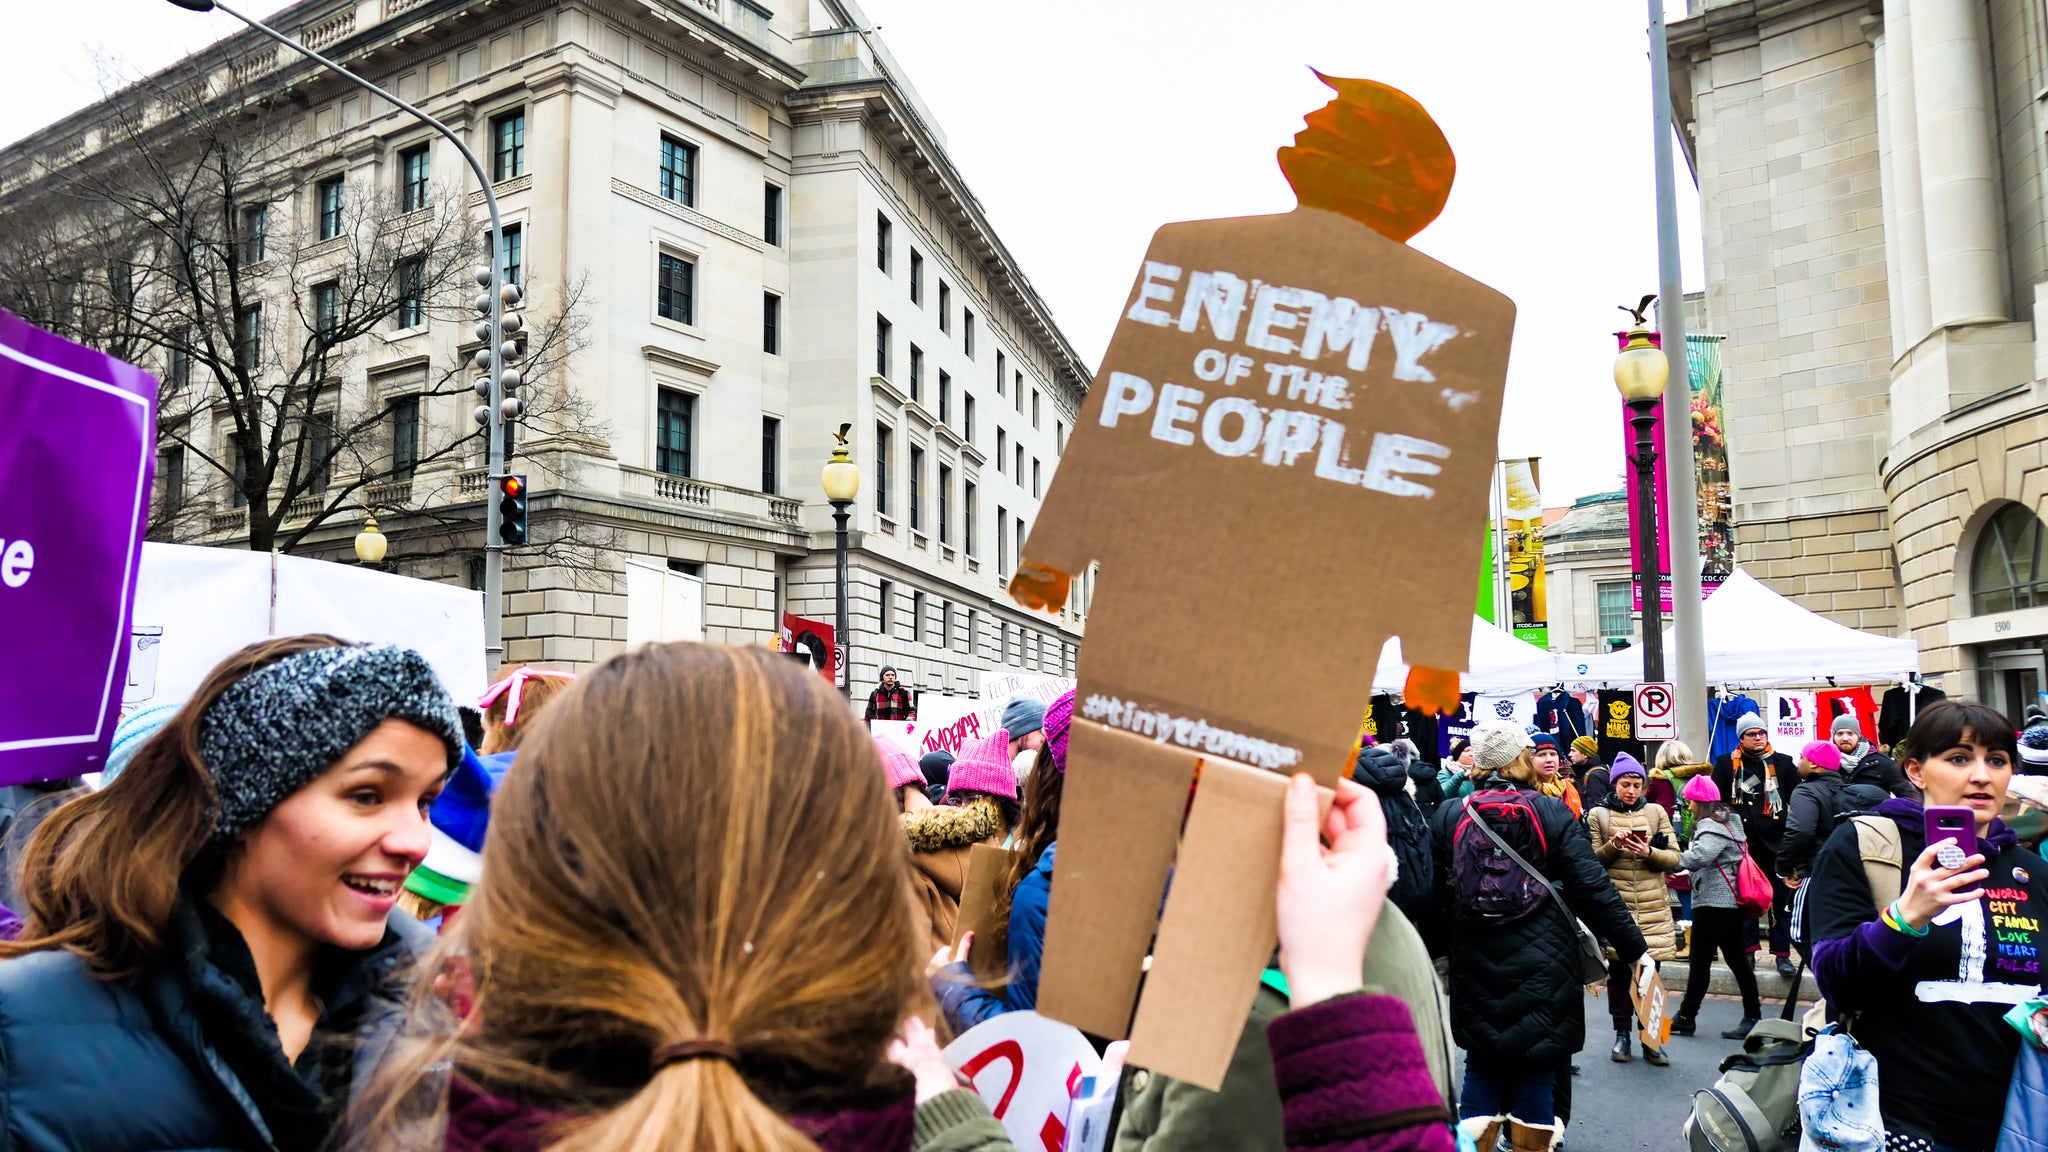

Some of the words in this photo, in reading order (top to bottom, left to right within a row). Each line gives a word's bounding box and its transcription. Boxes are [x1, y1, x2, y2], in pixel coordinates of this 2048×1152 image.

[1126, 260, 1459, 382] ENEMY
[1193, 348, 1254, 386] OF
[1264, 362, 1353, 410] THE
[1099, 371, 1451, 499] PEOPLE
[1606, 722, 1631, 732] MARCH
[1777, 727, 1805, 736] MARCH
[1985, 888, 2029, 902] WORLD
[1989, 901, 2017, 915] CITY
[1992, 915, 2040, 932] FAMILY
[1996, 929, 2032, 944] LOVE
[1998, 943, 2038, 958] HEART
[1996, 958, 2040, 973] PULSE
